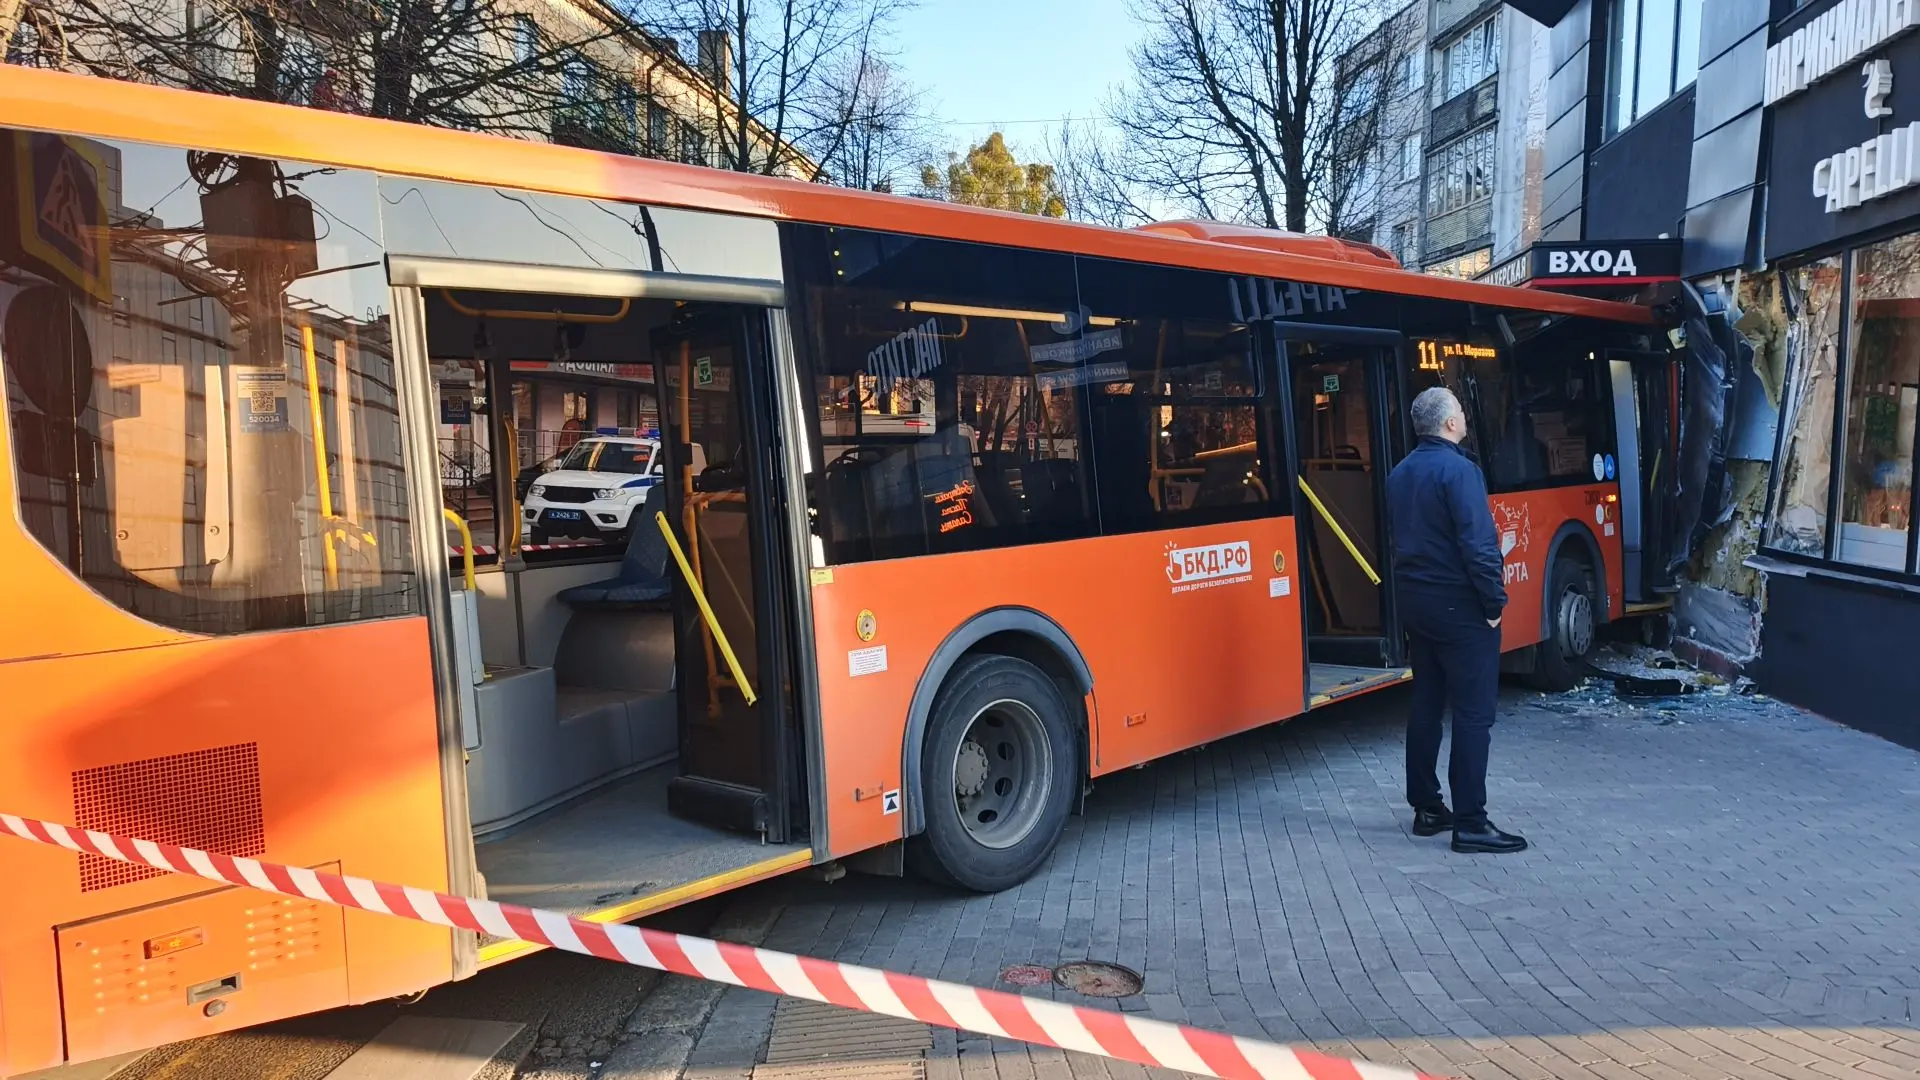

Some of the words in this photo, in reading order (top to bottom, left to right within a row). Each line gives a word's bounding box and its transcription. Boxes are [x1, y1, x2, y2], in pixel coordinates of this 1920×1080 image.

[1813, 121, 1918, 213] CAPELLI
[1482, 256, 1526, 287] АХЕРСКАЯ
[1549, 250, 1637, 276] ВХОД
[1418, 341, 1439, 369] 11
[248, 415, 280, 423] 520034
[1183, 546, 1248, 575] БКД.РФ
